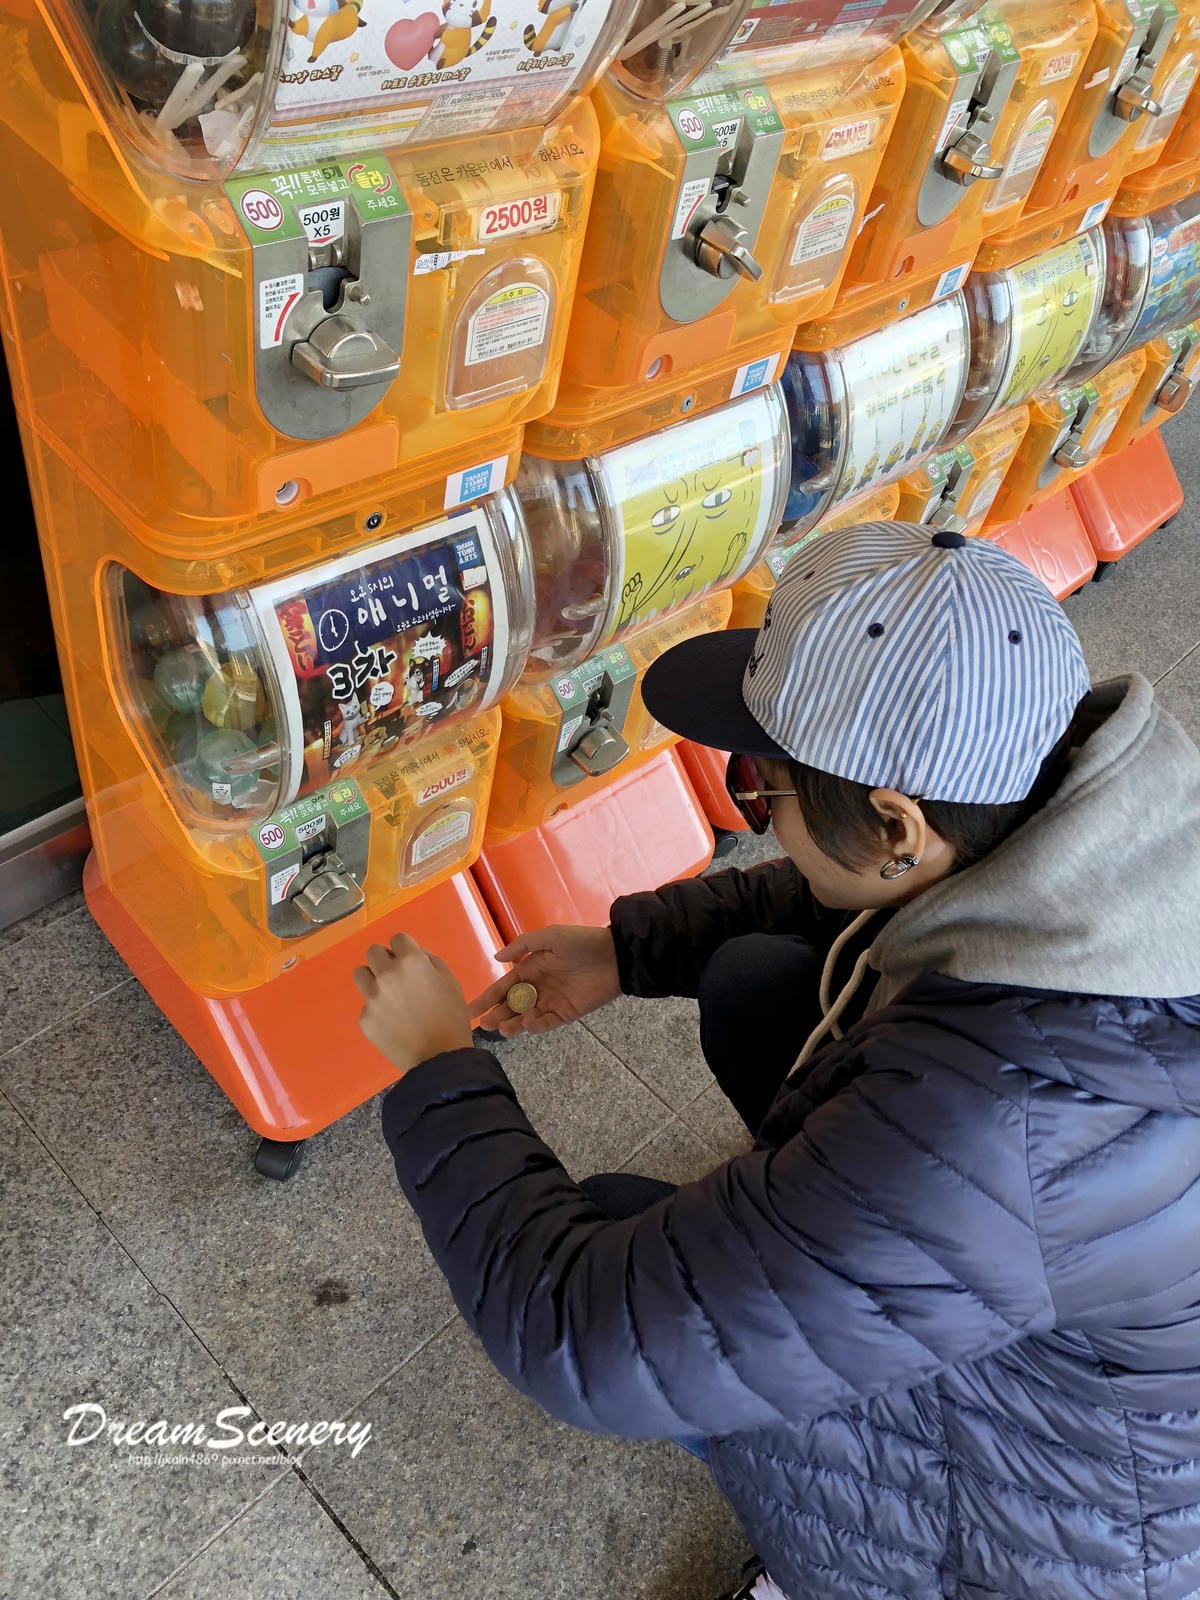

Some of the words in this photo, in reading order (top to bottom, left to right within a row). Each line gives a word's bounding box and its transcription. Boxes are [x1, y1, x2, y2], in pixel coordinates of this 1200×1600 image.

[310, 64, 344, 82] 라스칼
[679, 116, 703, 134] 500
[756, 115, 777, 128] 주세요
[355, 170, 384, 189] 돌려
[416, 167, 455, 188] 동전은
[246, 198, 280, 222] 500
[366, 195, 399, 211] 주세요
[303, 206, 341, 226] 500원
[485, 196, 549, 235] 2500원
[455, 540, 475, 551] TAKARA
[457, 546, 476, 557] TOMY
[459, 552, 478, 564] ARTS
[350, 585, 367, 602] 오후
[326, 640, 398, 699] 3차
[558, 681, 575, 697] 500
[421, 767, 467, 800] 2500원
[339, 801, 361, 817] 주세요
[261, 826, 283, 846] 500
